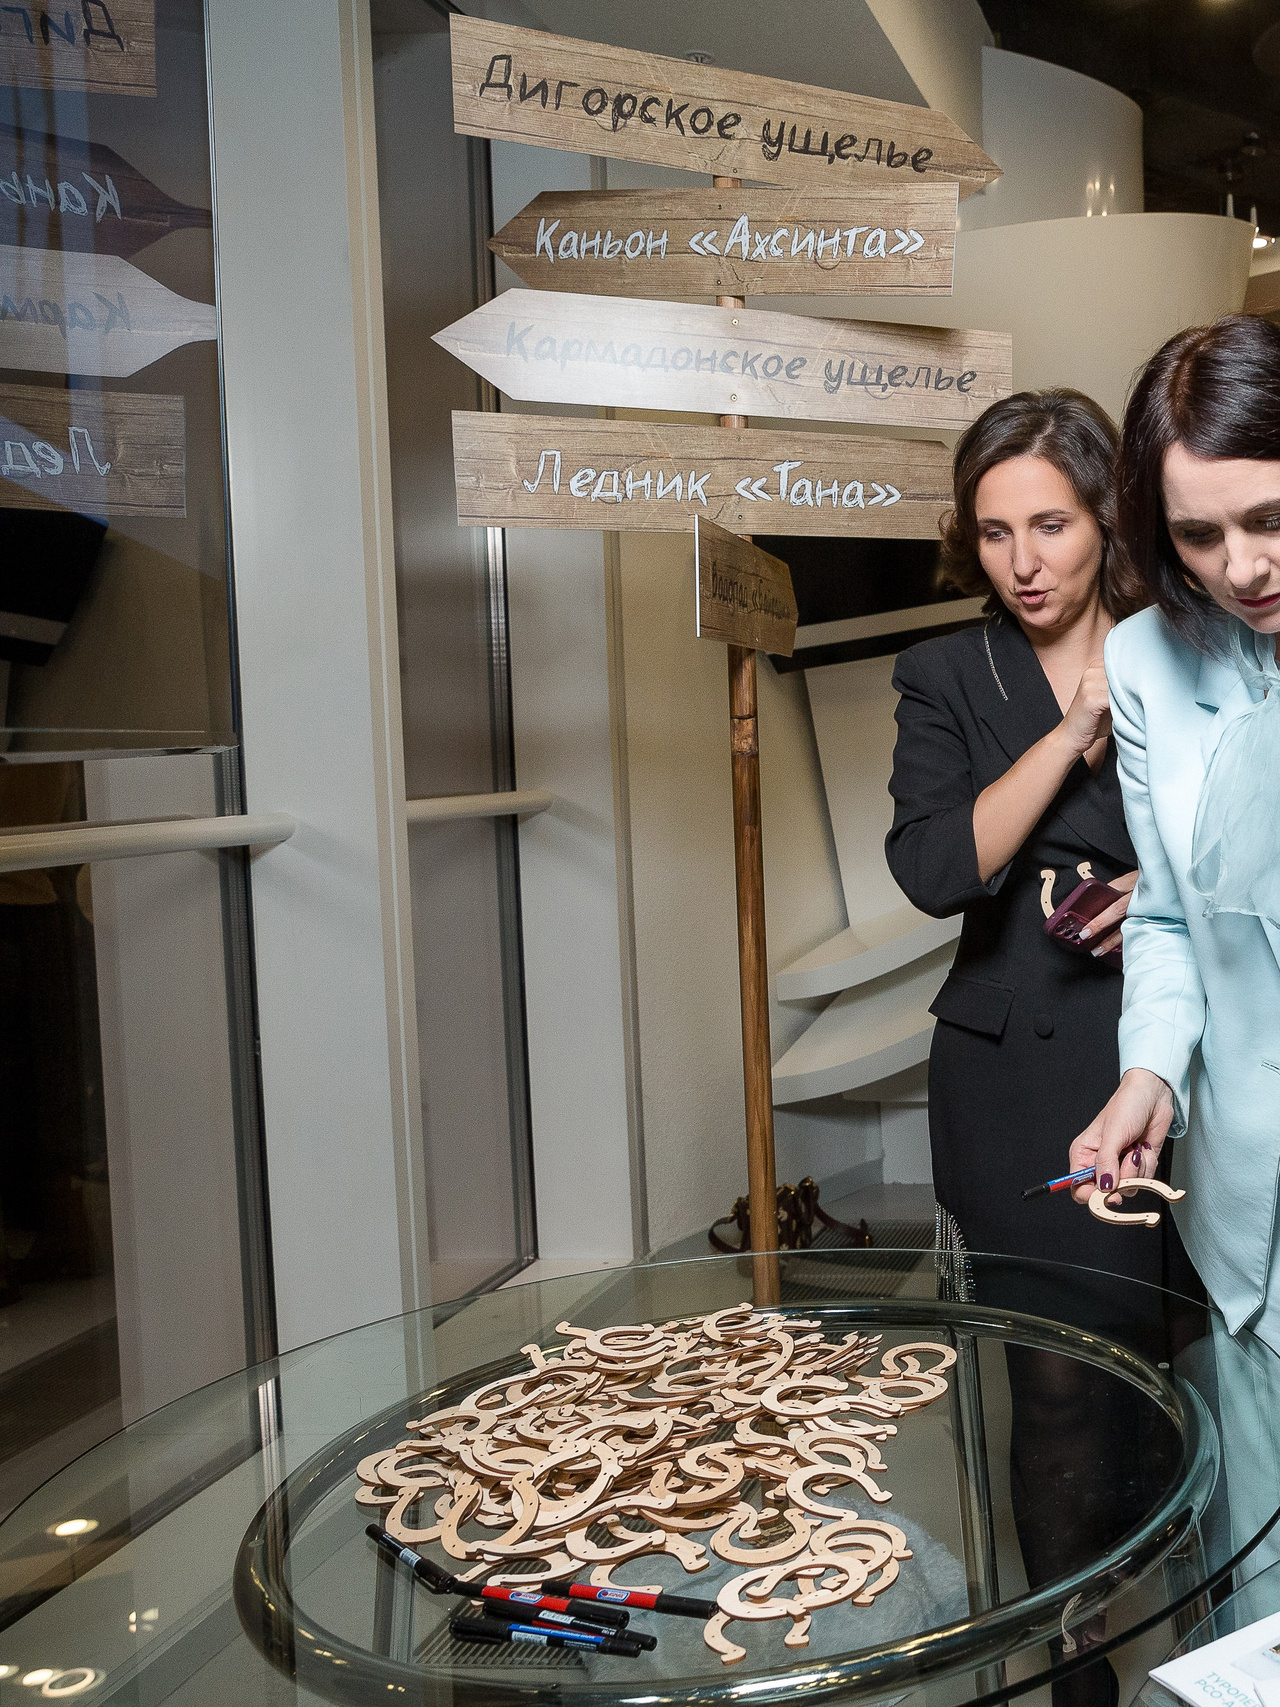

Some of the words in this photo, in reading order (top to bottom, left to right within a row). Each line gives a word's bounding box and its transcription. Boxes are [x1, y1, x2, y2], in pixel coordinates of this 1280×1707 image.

[478, 54, 742, 140] Дигорское
[761, 117, 934, 174] ущелье
[535, 217, 669, 265] Каньон
[688, 212, 926, 262] «Ахсинта»
[505, 320, 808, 381] Кармадонское
[824, 354, 978, 395] ущелье
[522, 449, 709, 507] Ледник
[734, 460, 903, 511] «Тана»
